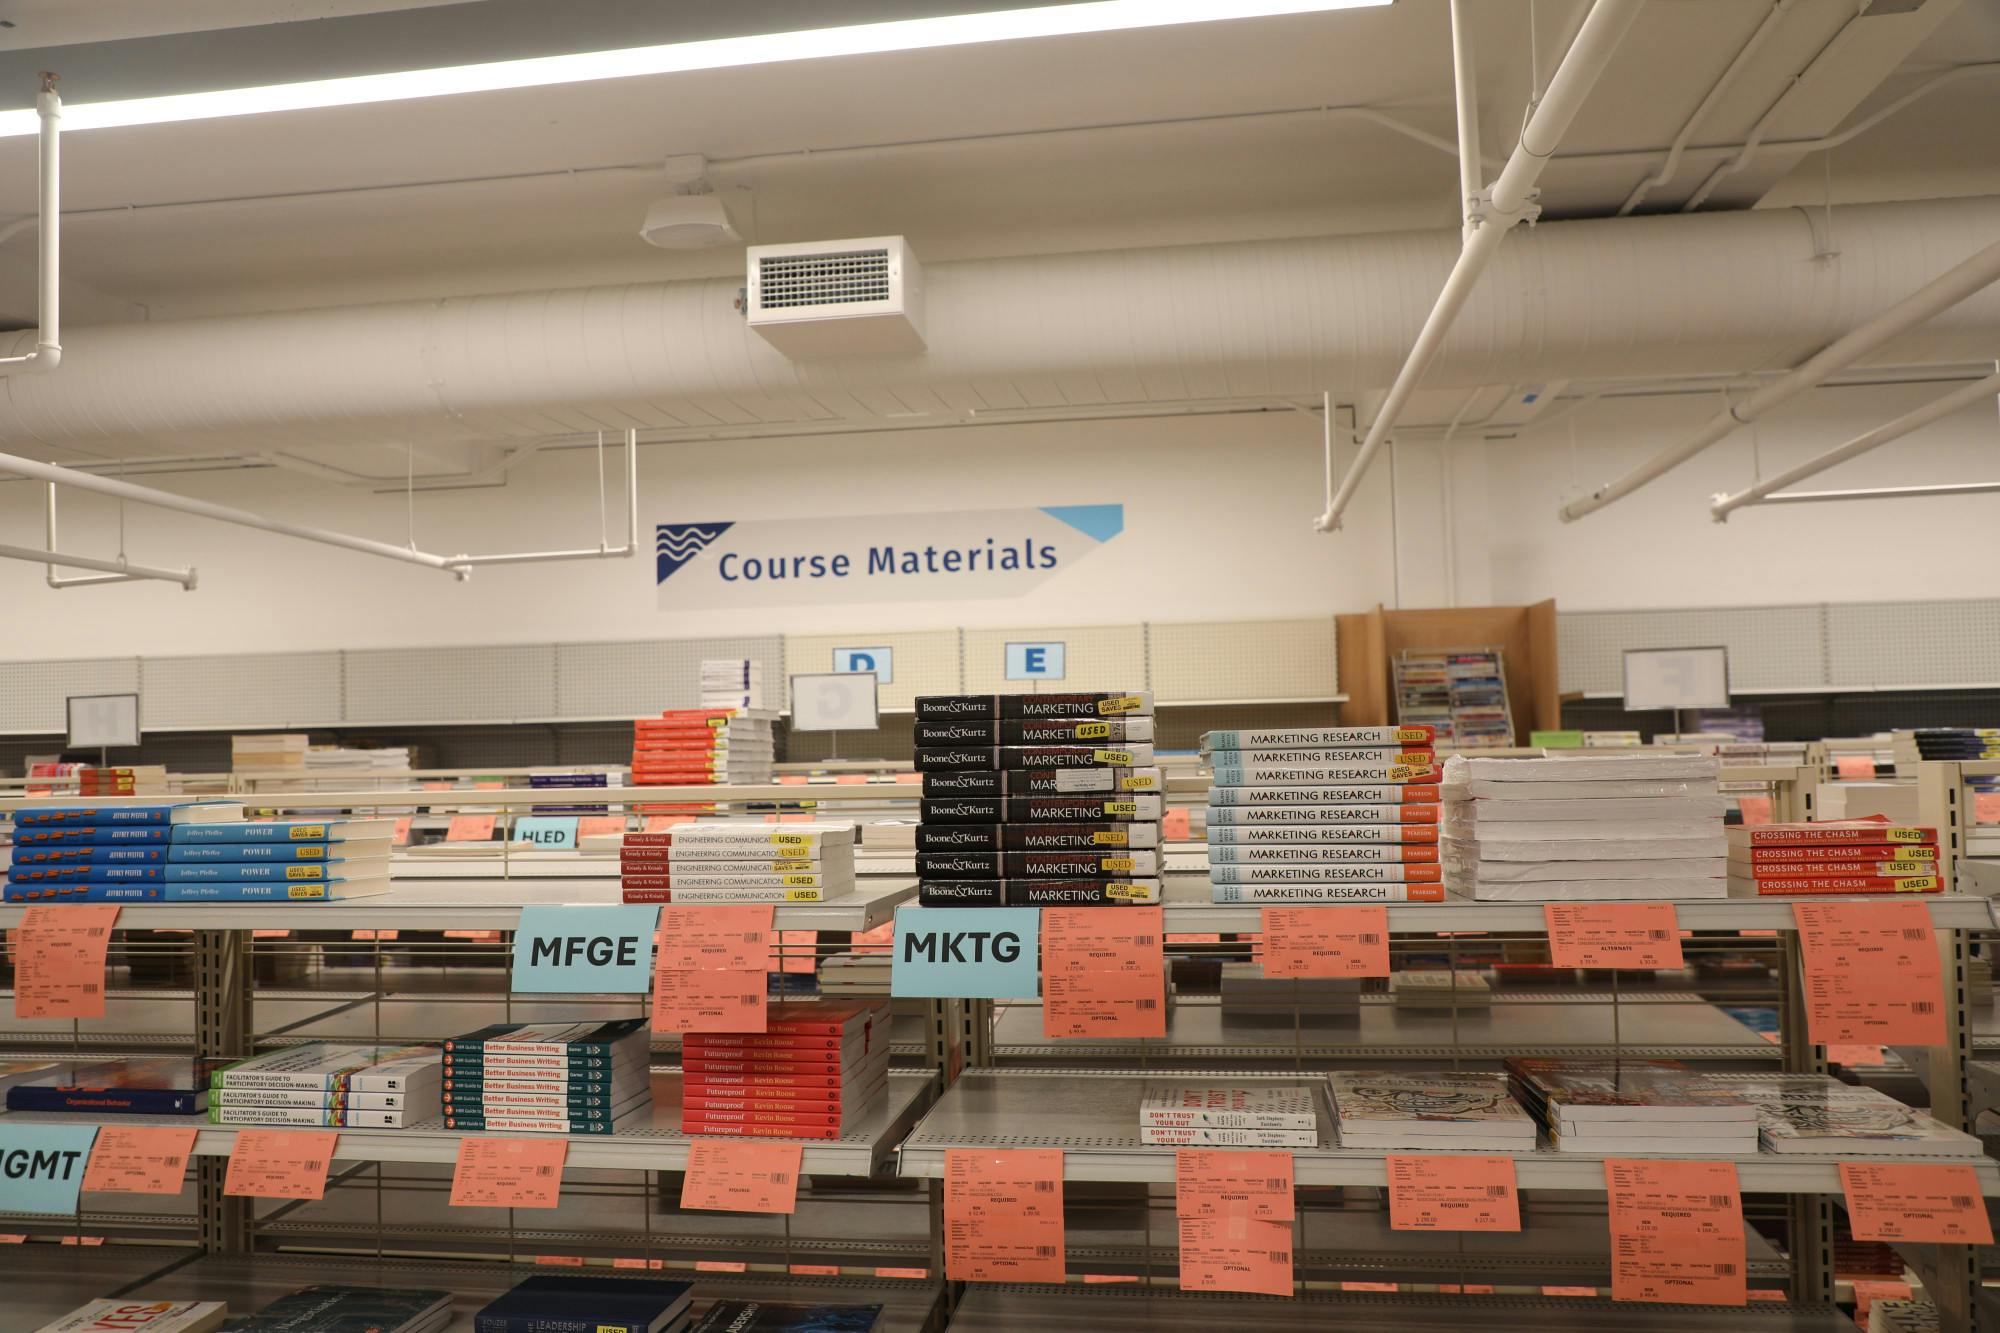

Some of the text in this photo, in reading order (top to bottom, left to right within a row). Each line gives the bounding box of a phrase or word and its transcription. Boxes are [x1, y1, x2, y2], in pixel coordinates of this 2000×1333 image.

[719, 537, 1058, 582] Course Materials
[849, 653, 875, 671] D
[1025, 648, 1046, 673] E
[1023, 703, 1094, 715] MARKETING
[1023, 728, 1077, 740] MARKETI
[1080, 726, 1106, 736] USED
[1397, 731, 1423, 740] USED
[1250, 732, 1381, 745] MARKETING RESEARCH
[1022, 754, 1093, 766] MARKETING
[1104, 753, 1128, 762] USED
[1253, 751, 1382, 762] MARKETING RESEARCH
[1400, 755, 1426, 764] USED
[1255, 769, 1387, 781] MARKETING RESEARCH
[1392, 766, 1410, 774] USED
[1392, 771, 1413, 780] SAVES
[1126, 777, 1152, 788] USED
[1250, 790, 1382, 801] MARKETING RESEARCH
[1031, 807, 1101, 819] MARKETING
[1112, 804, 1137, 812] USED
[1247, 810, 1379, 820] MARKETING RESEARCH
[245, 828, 273, 836] POWER
[522, 830, 565, 843] HLED
[1248, 829, 1381, 840] MARKETING RESEARCH
[1754, 830, 1859, 840] CROSSING THE CHASM
[1895, 831, 1921, 839] USED
[678, 836, 771, 844] ENGINEERING COMMUNICAT
[779, 836, 801, 844] USED
[1025, 835, 1096, 846] MARKETING
[1098, 834, 1124, 842] USED
[243, 848, 271, 856] POWER
[676, 850, 778, 858] ENGINEERING COMMUNICATIO
[781, 848, 805, 856] USED
[1249, 849, 1381, 859] MARKETING RESEARCH
[1756, 849, 1861, 858] CROSSING THE CHASM
[1908, 849, 1935, 858] USED
[677, 864, 772, 872] ENGINEERING COMMUNICATI
[1026, 863, 1097, 874] MARKETING
[1105, 860, 1131, 868] USED
[1756, 864, 1803, 873] CROSSING
[1806, 864, 1824, 872] THE
[1890, 863, 1916, 871] USED
[241, 868, 270, 876] POWER
[1251, 869, 1383, 879] MARKETING RESEARCH
[677, 878, 784, 886] ENGINEERING COMMUNICATION
[1761, 880, 1866, 889] CROSSING THE CHASM
[1902, 879, 1929, 888] USED
[678, 892, 785, 900] ENGINEERING COMMUNICATION
[794, 891, 818, 899] USED
[1029, 890, 1100, 901] MARKETING
[1253, 888, 1386, 898] MARKETING RESEARCH
[531, 936, 639, 967] MFGE
[904, 932, 1021, 964] MKTG
[484, 1043, 560, 1054] Better Business Writing
[484, 1056, 560, 1066] Better Business Writing
[706, 1088, 795, 1098] Futureproof Kevin Roose
[223, 1098, 316, 1107] PARTICIPATORY DECISION-MAKING
[705, 1100, 744, 1110] Futureproof
[754, 1102, 773, 1110] Kevin
[486, 1120, 562, 1131] Better Business Writing
[703, 1125, 793, 1136] Futureproof Kevin Roose
[536, 1320, 586, 1332] LEADERSHIP
